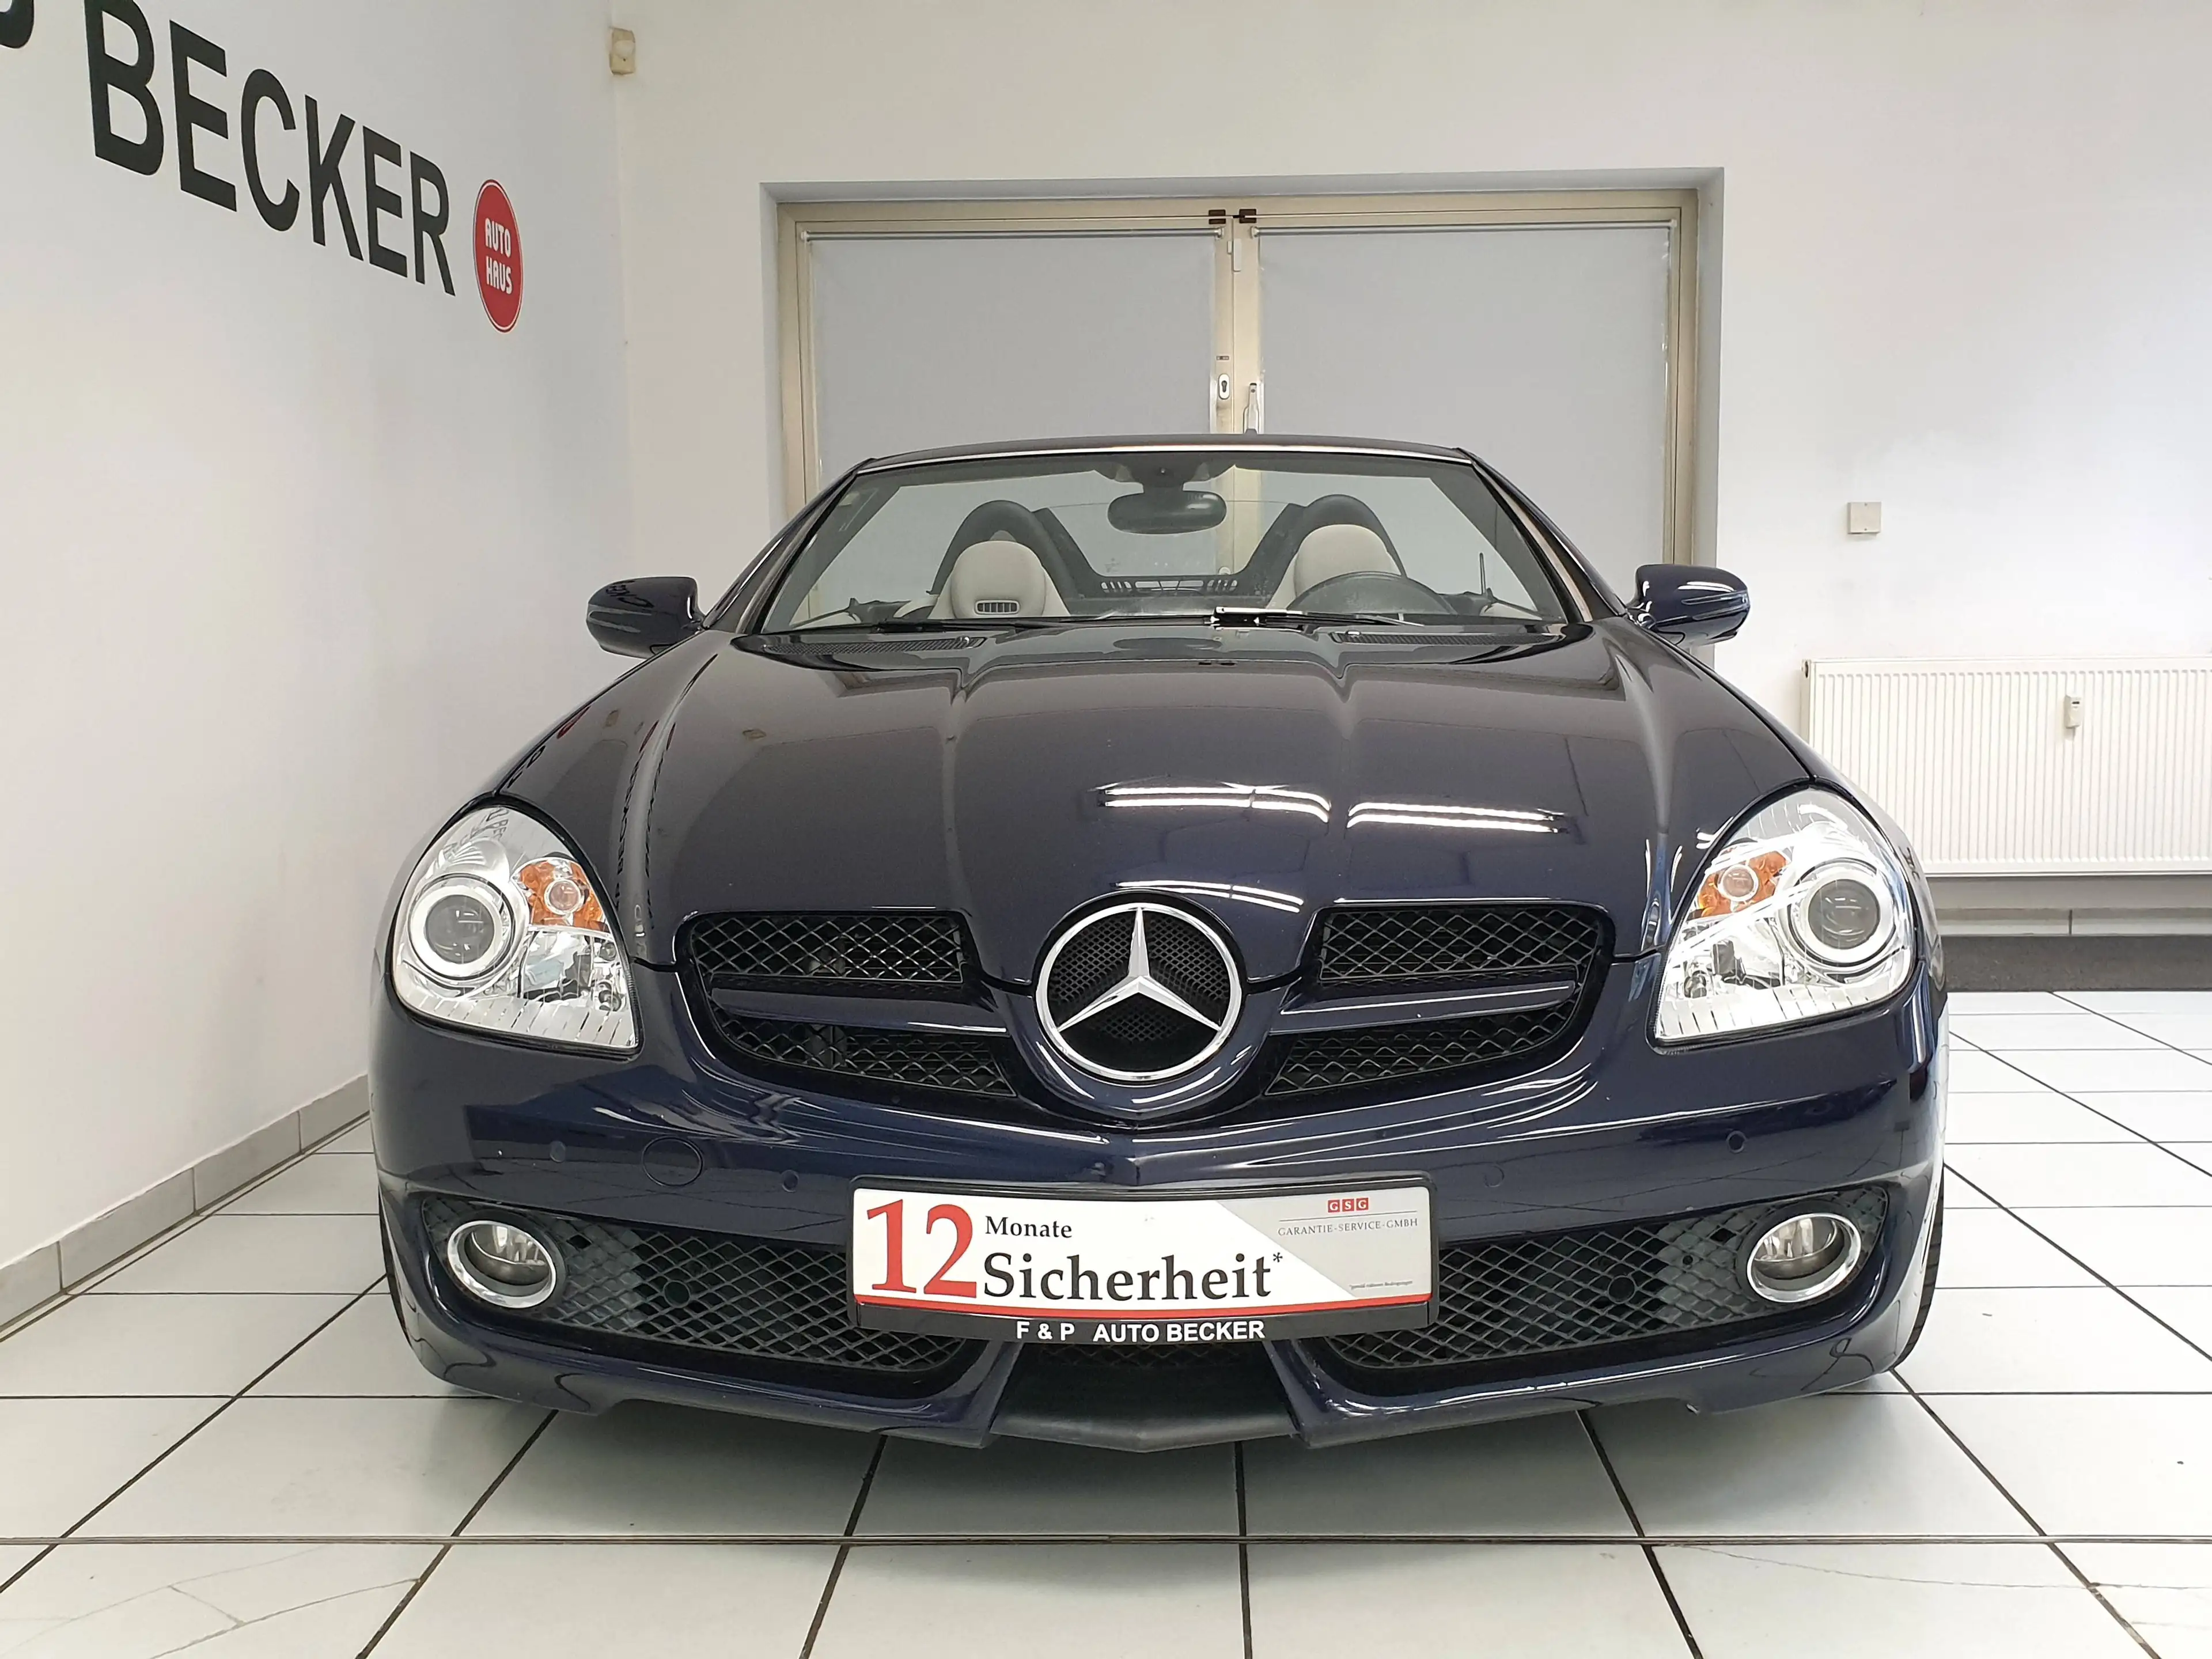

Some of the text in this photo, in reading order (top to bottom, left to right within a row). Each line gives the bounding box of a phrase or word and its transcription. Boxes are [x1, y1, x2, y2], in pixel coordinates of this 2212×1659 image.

[84, 0, 456, 297] BECKER
[485, 218, 512, 258] AUTO
[486, 256, 513, 294] HAUS
[1328, 1198, 1368, 1212] GSG
[985, 1215, 1073, 1238] Monate
[866, 1199, 977, 1298] 12
[1017, 1320, 1266, 1343] F & P AUTO BECKER
